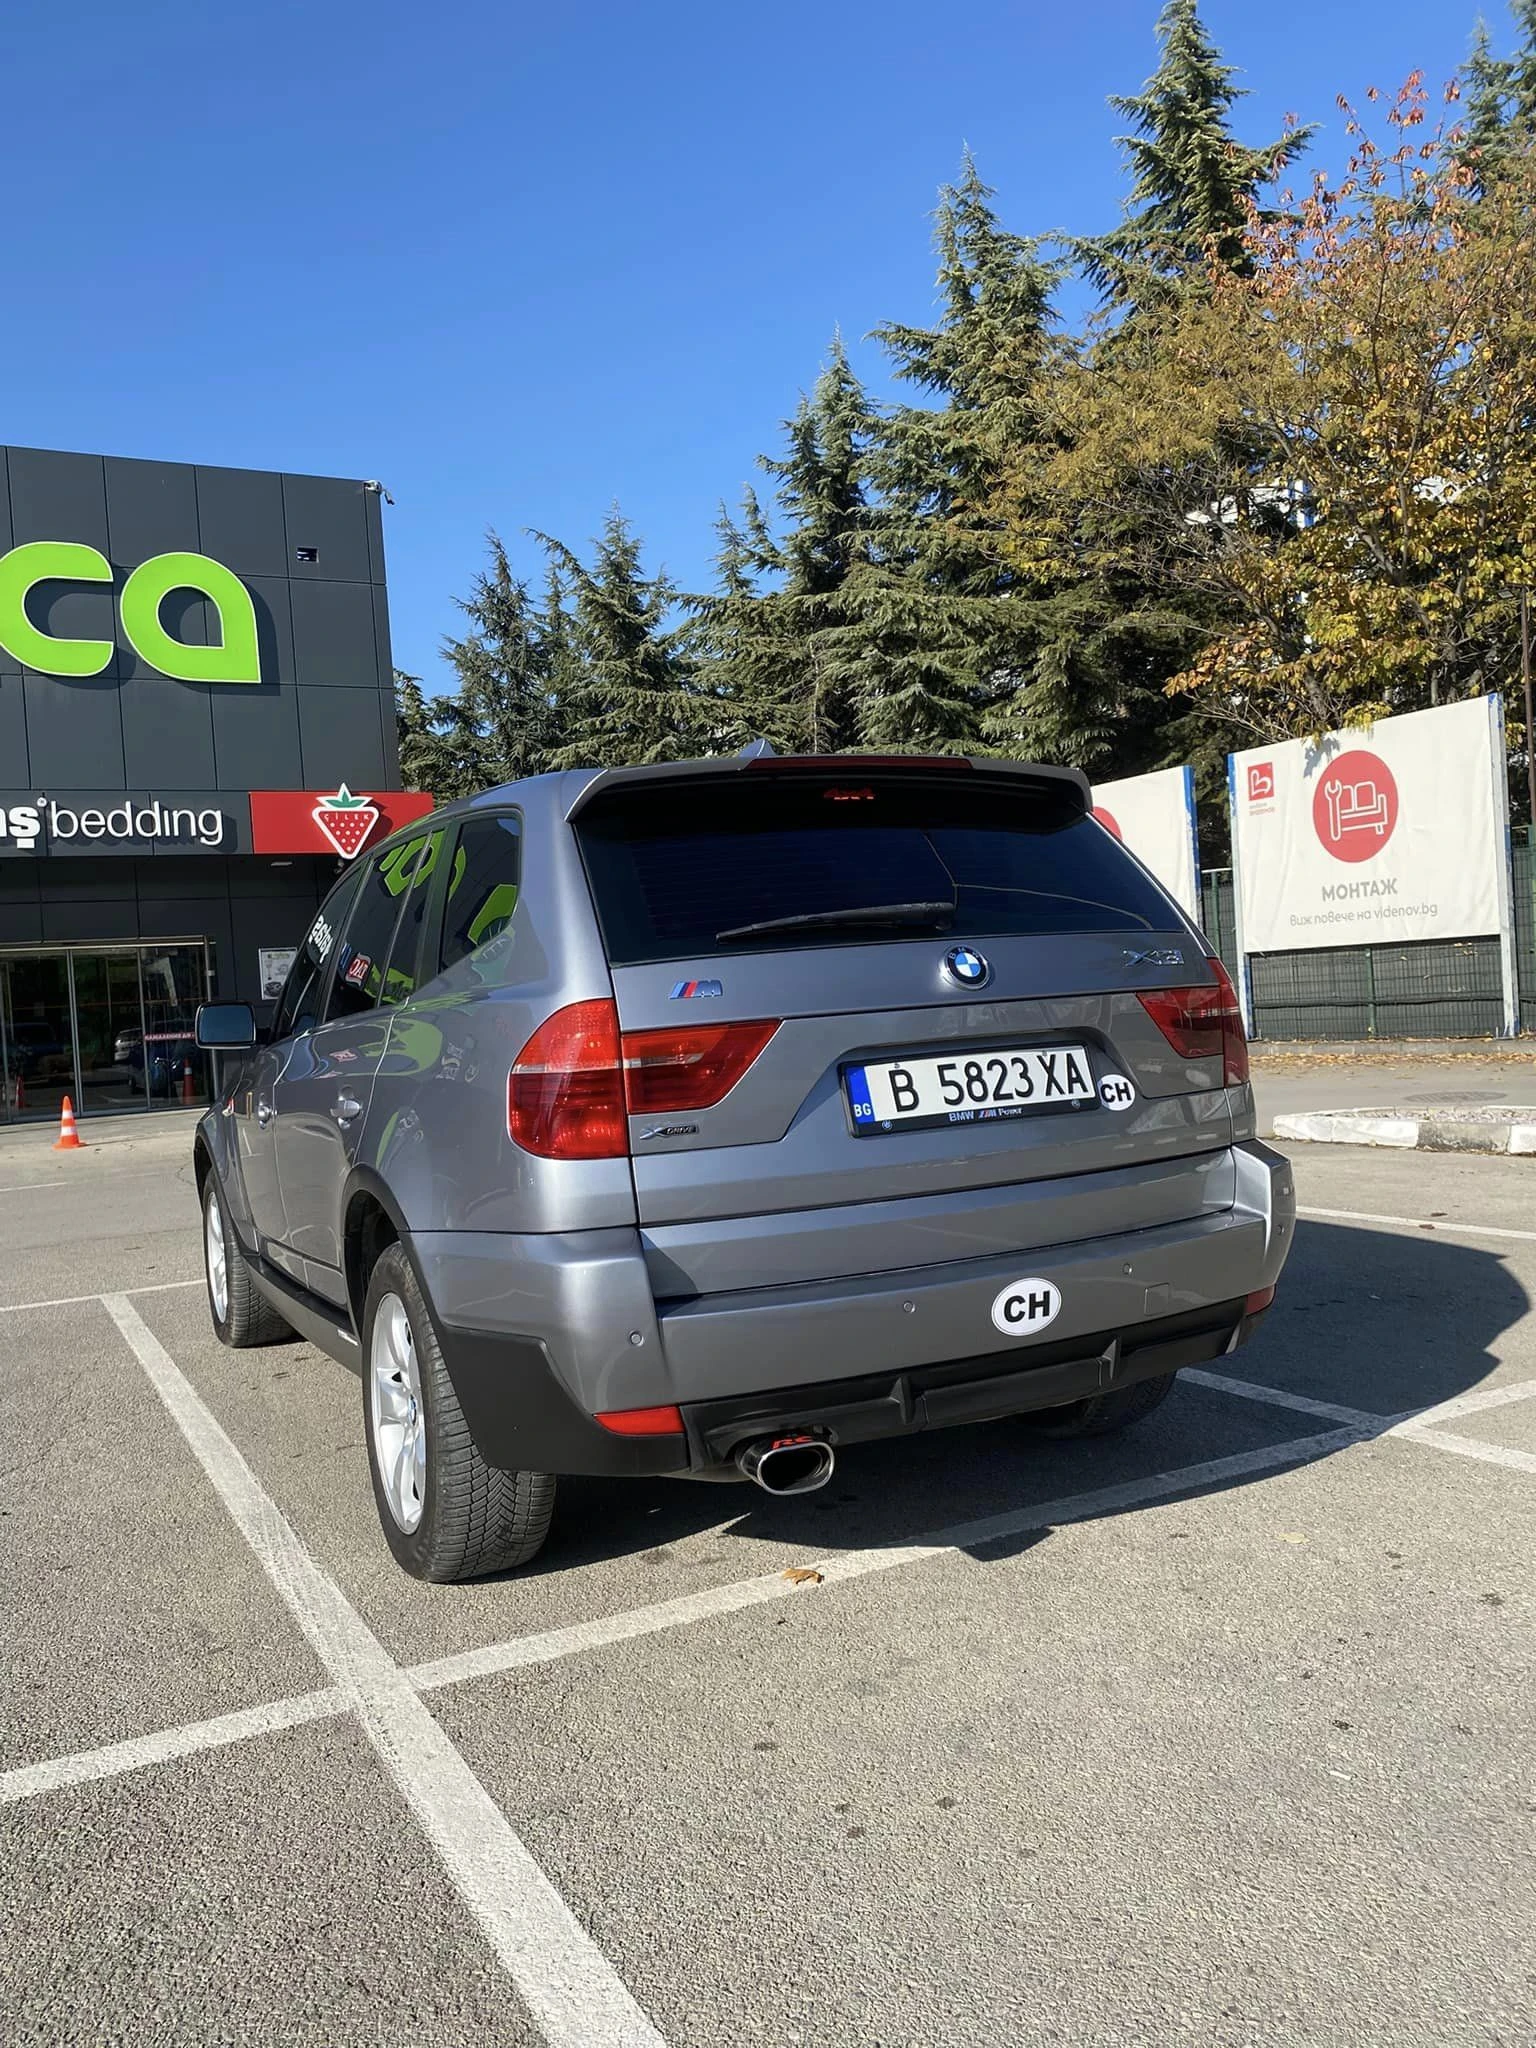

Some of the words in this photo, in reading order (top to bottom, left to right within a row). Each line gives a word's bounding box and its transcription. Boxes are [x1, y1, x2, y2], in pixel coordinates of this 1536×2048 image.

[1321, 878, 1398, 901] МОНТАЖ
[1357, 910, 1371, 921] на
[1374, 902, 1438, 919] videnov.bg
[889, 1068, 919, 1113] B
[937, 1057, 1034, 1106] 5823
[1037, 1053, 1088, 1097] XA
[1101, 1081, 1132, 1103] CH
[854, 1103, 872, 1117] BG
[949, 1110, 974, 1122] BMW
[1004, 1290, 1050, 1323] CH
